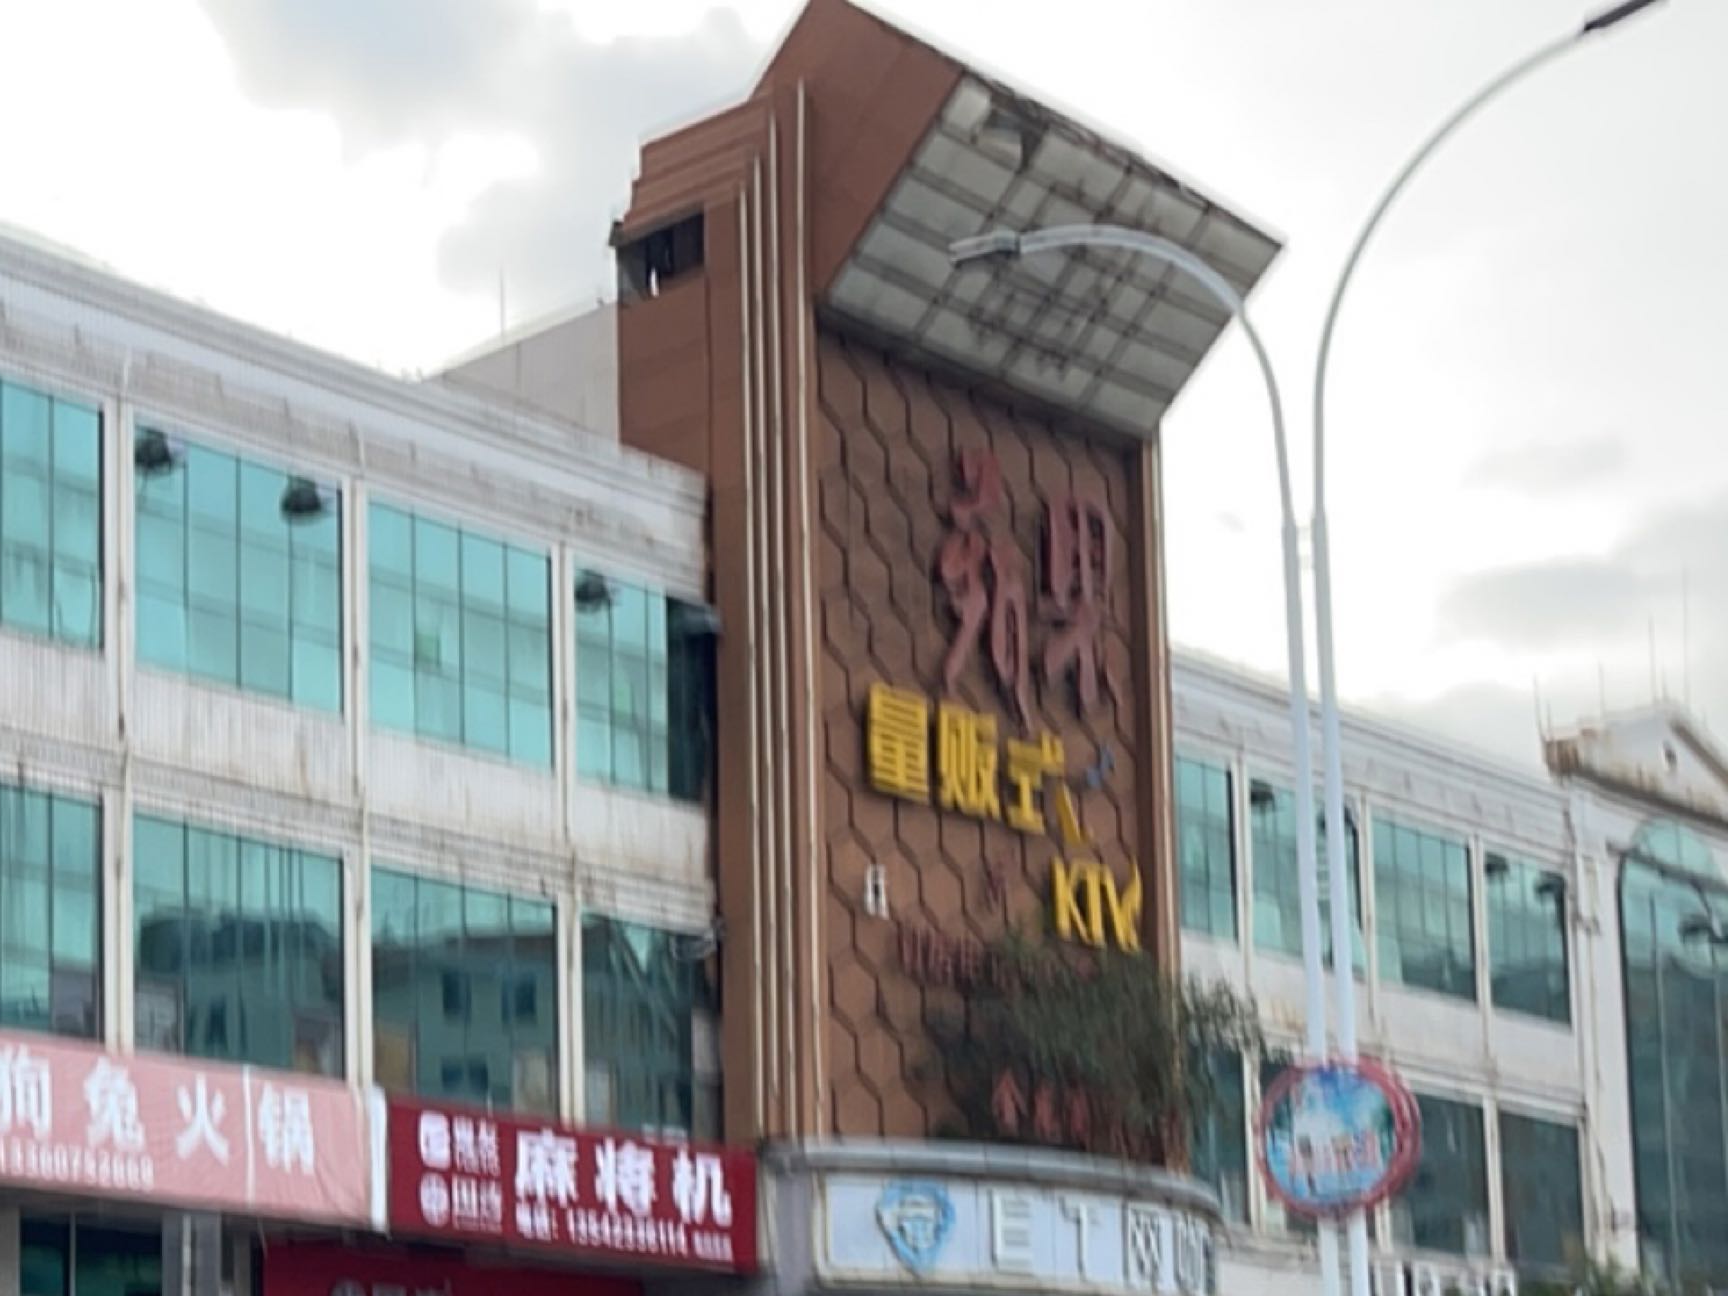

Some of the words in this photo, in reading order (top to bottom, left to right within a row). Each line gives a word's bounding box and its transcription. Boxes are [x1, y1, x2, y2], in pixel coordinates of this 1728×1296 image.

[1051, 857, 1144, 954] KTV
[515, 1128, 734, 1228] 麻将机
